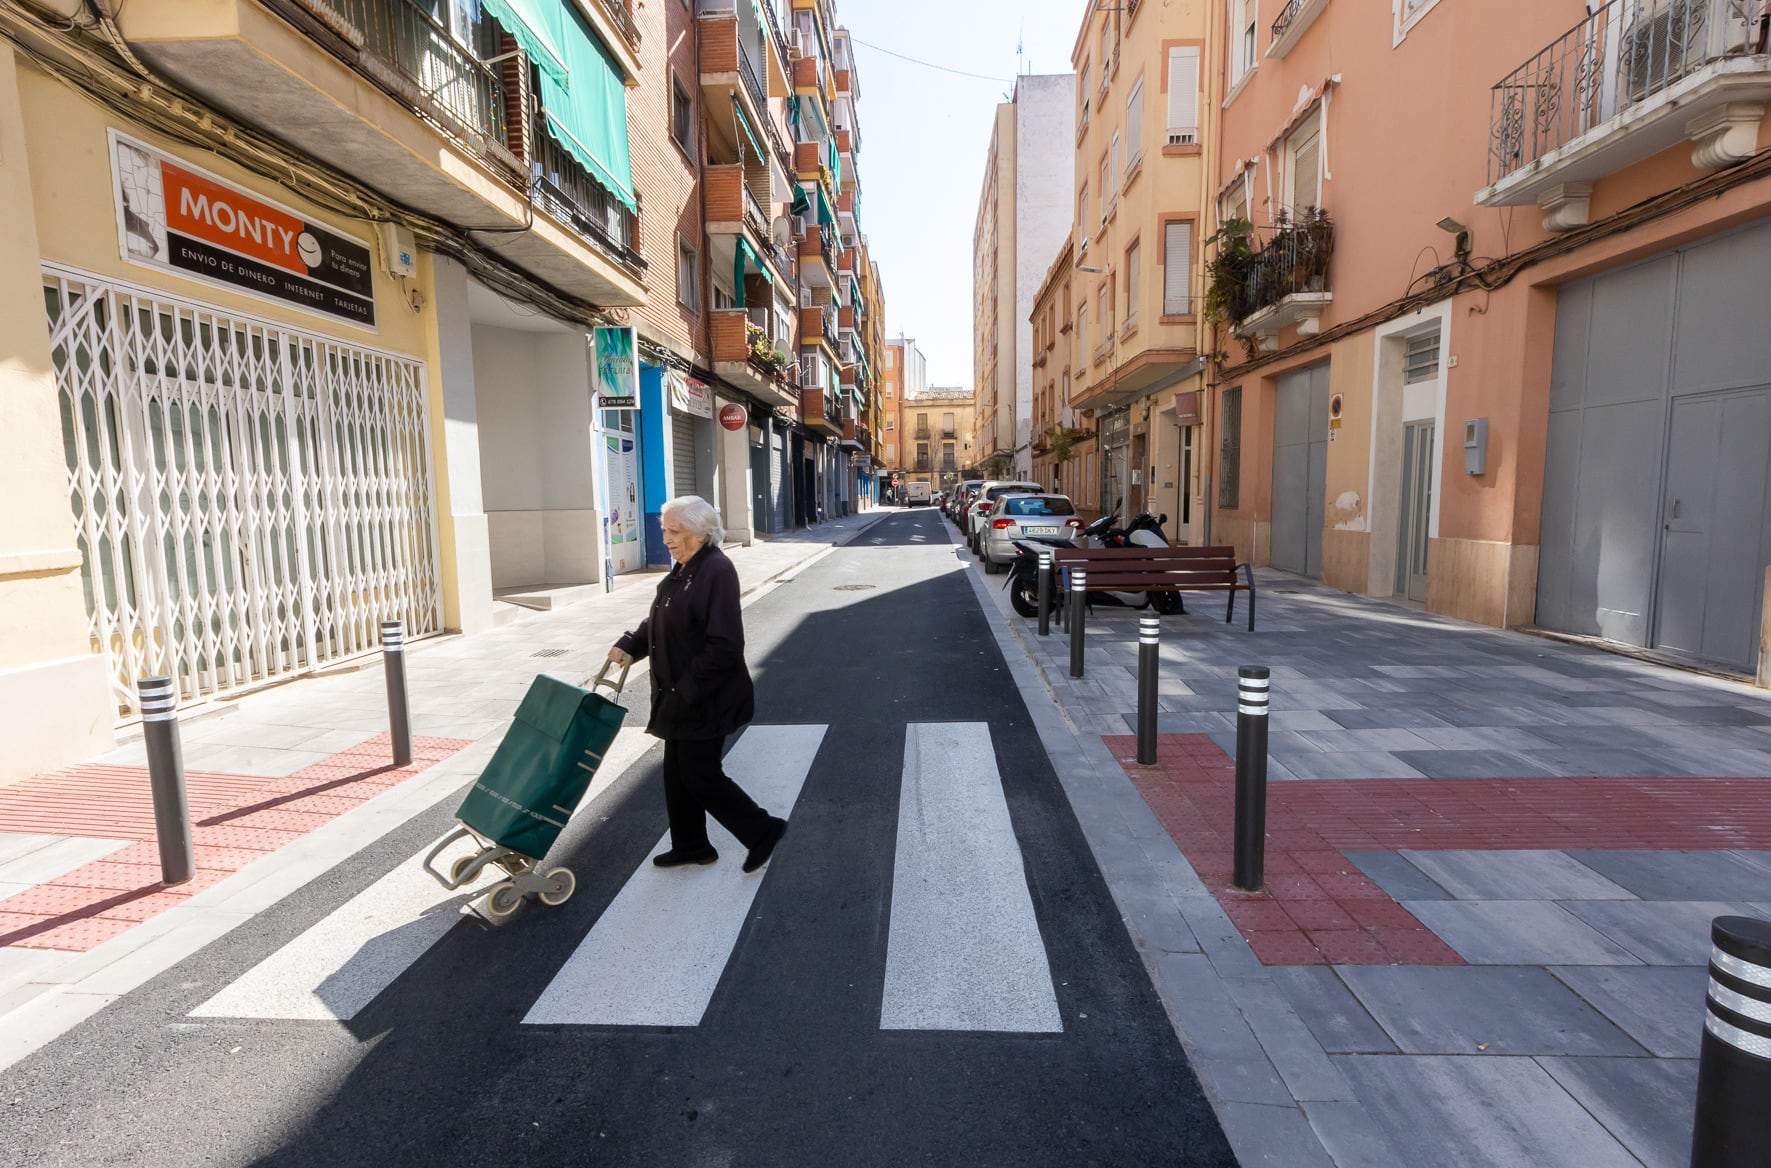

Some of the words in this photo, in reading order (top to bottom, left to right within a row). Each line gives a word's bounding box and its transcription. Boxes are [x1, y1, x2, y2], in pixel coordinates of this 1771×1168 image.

[180, 187, 294, 255] MONTY
[181, 248, 217, 266] ENVIO
[221, 261, 234, 273] DE
[238, 266, 276, 286] DINERO
[284, 281, 324, 301] INTERNET
[334, 297, 368, 315] TARJETAS
[331, 249, 347, 262] Para
[348, 259, 367, 271] enviar
[331, 261, 339, 269] tu
[340, 264, 360, 278] dinero
